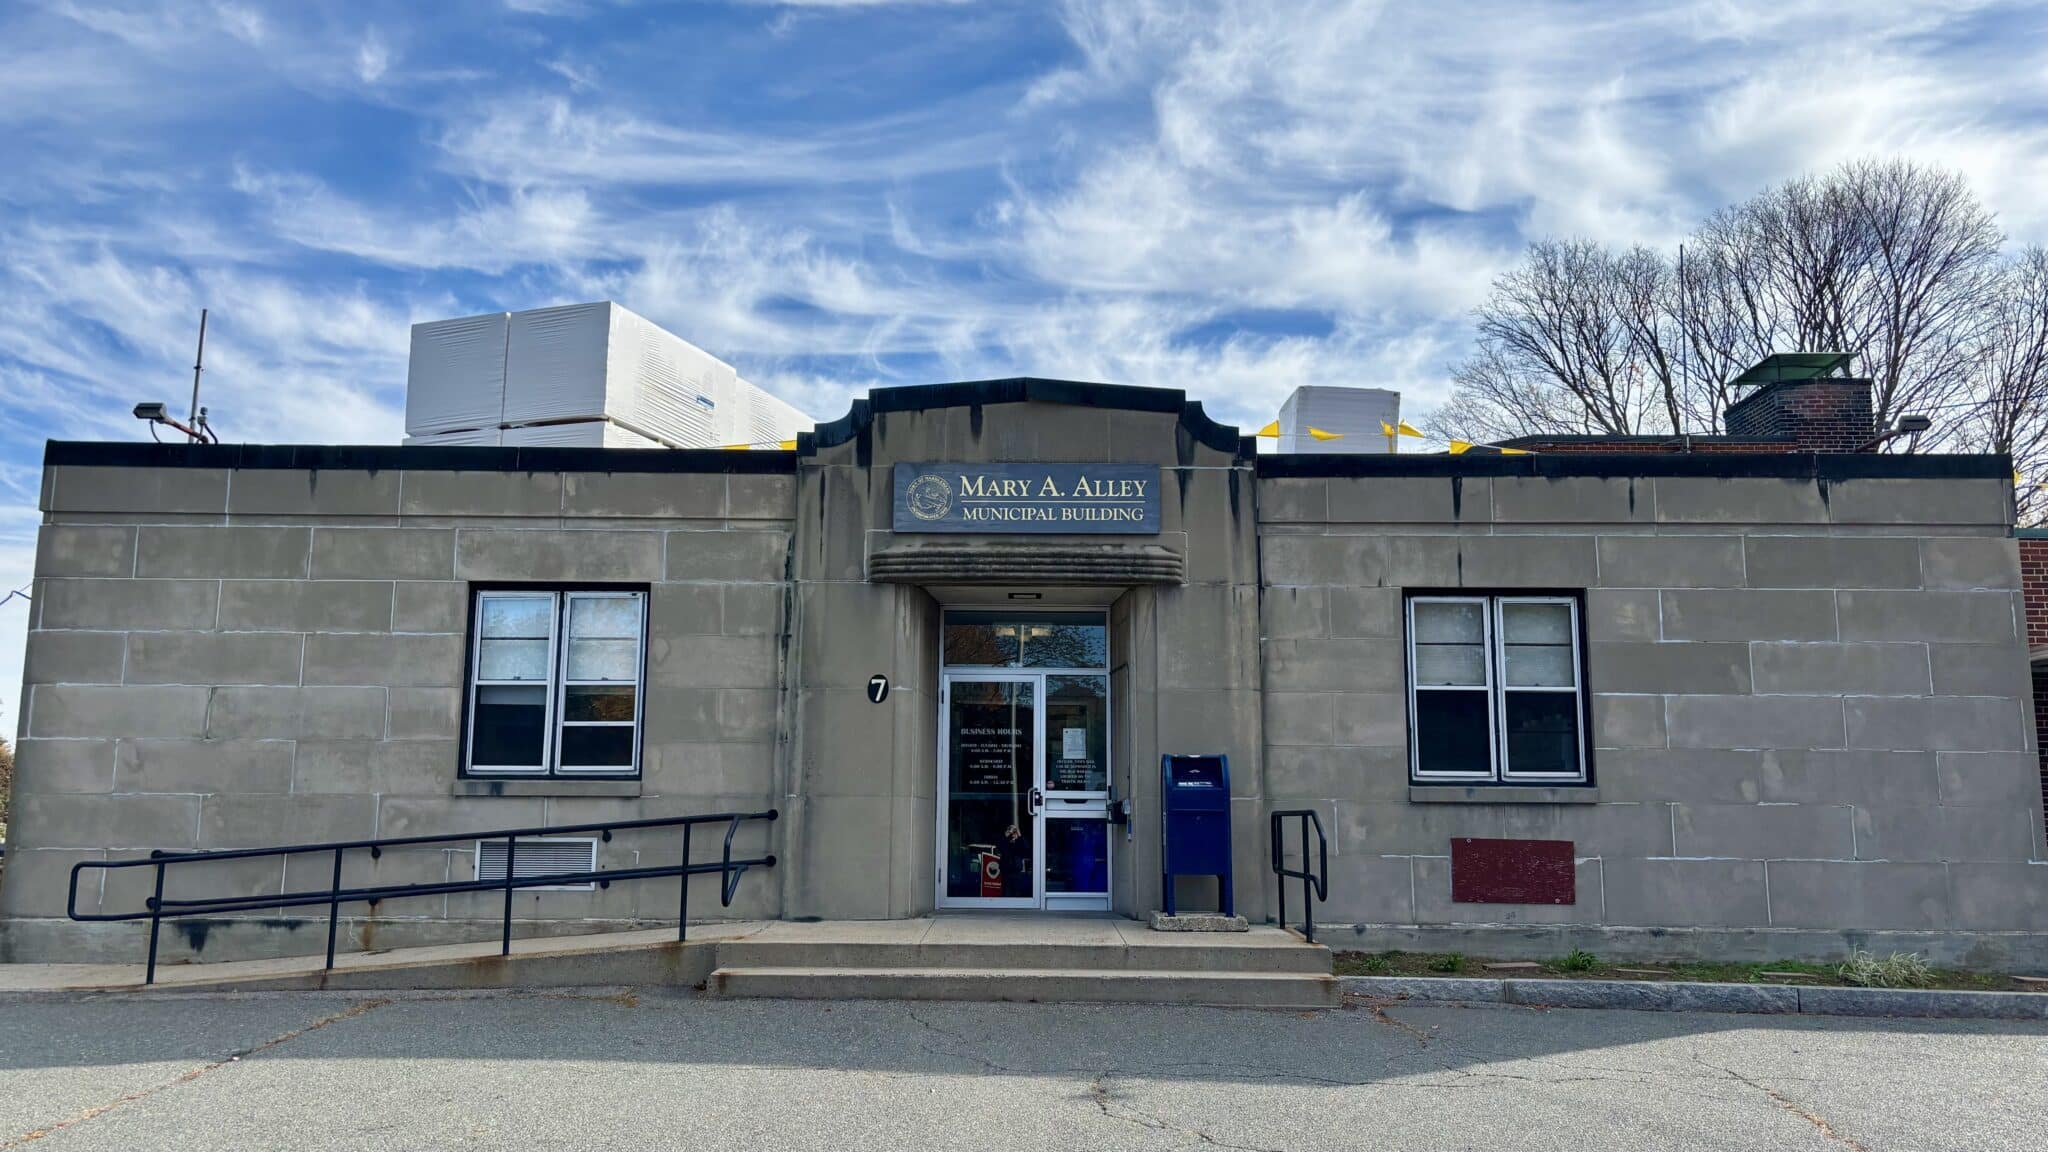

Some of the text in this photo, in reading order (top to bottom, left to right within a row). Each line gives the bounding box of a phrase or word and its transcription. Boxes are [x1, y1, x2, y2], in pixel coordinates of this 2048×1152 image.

[960, 475, 1148, 497] MARY A. ALLEY
[963, 507, 1145, 521] MUNICIPAL BUILDING
[871, 678, 886, 702] 7
